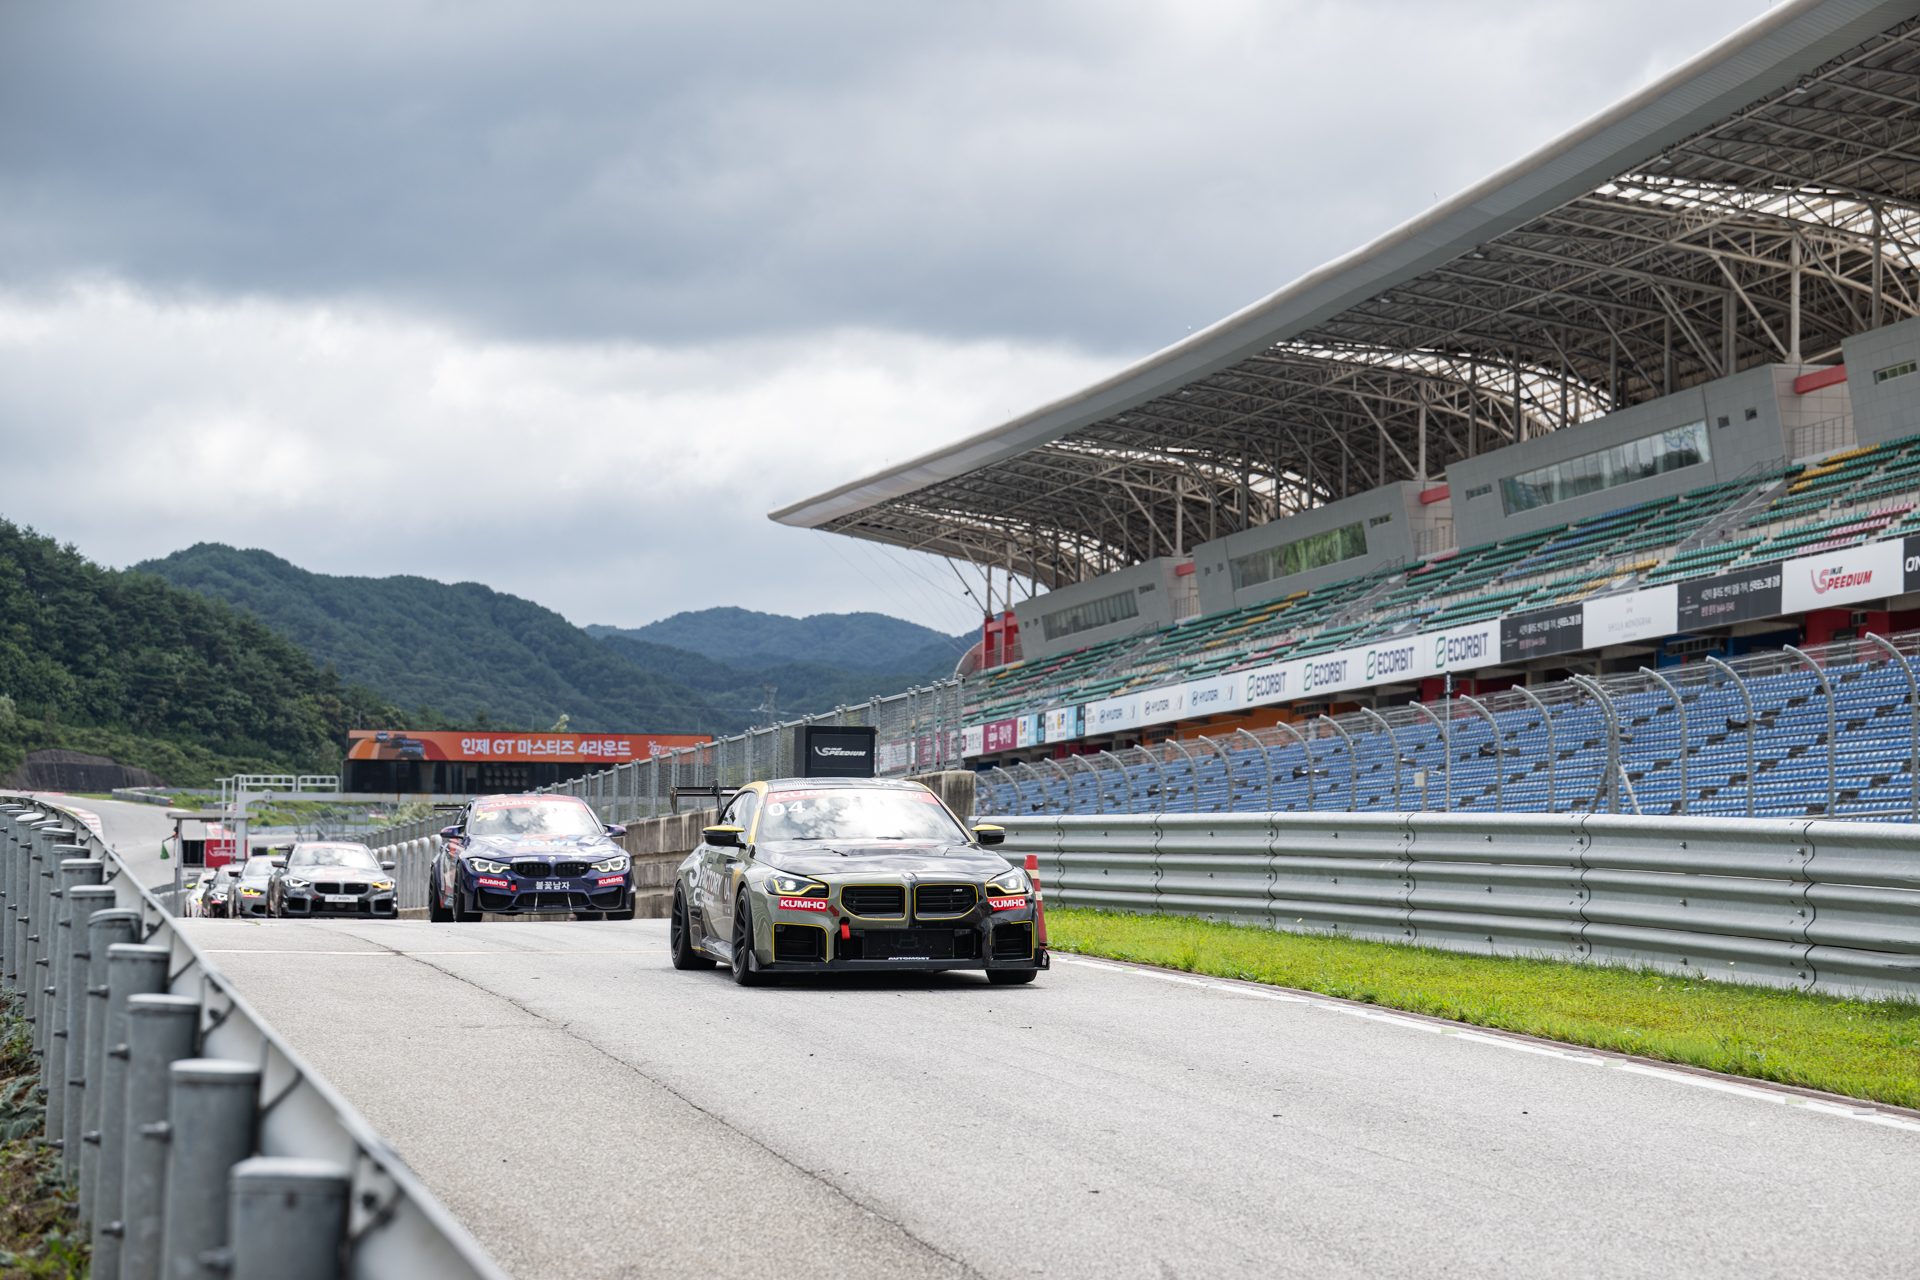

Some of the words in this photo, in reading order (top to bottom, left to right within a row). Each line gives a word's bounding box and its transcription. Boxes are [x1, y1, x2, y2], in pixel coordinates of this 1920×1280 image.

[1448, 633, 1488, 662] ECORBIT
[1377, 647, 1414, 675] ECORBIT
[1314, 660, 1347, 686] ECORBIT
[1256, 672, 1287, 697] ECORBIT
[461, 738, 490, 755] 인제
[493, 740, 515, 754] GT
[518, 739, 575, 756] 마스터즈
[577, 740, 632, 757] 4라운드
[767, 801, 806, 817] 04
[479, 878, 508, 887] KUMHO
[598, 876, 624, 885] KUMHO
[780, 899, 826, 910] KUMHO
[989, 898, 1026, 908] KUMHO
